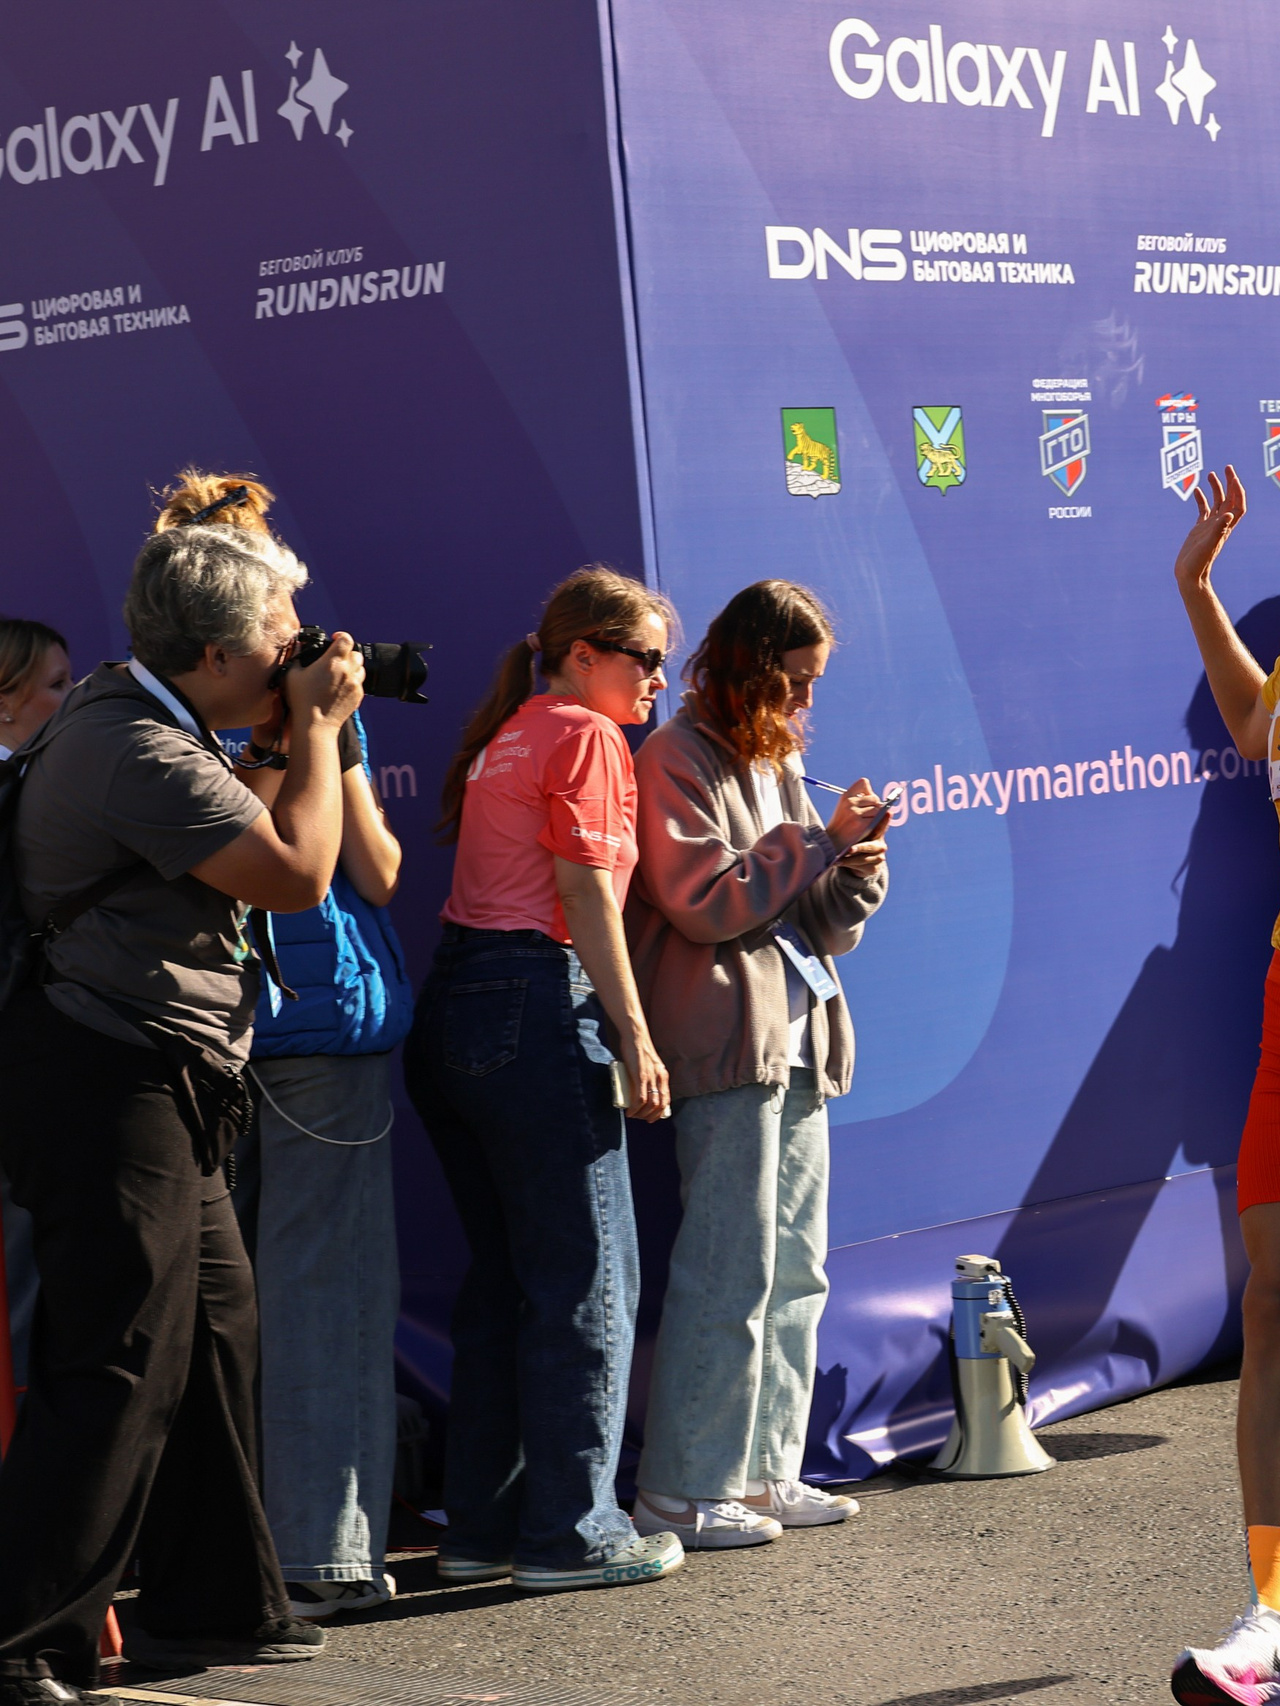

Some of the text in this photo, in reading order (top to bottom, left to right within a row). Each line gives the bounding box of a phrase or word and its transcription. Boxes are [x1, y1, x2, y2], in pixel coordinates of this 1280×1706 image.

[829, 17, 1141, 138] Galaxy AI
[0, 69, 260, 187] alaxy AI
[765, 226, 907, 282] DNS
[911, 229, 1028, 257] ЦИФРОВАЯ И
[1137, 233, 1227, 255] БЕГОВОЙ КЛУБ
[258, 246, 364, 277] БЕГОВОЙ КЛУБ
[912, 258, 1075, 286] БЫТОВАЯ ТЕХНИКА
[31, 283, 142, 321] ЦИФРОВАЯ И
[255, 261, 447, 320] RUNDNSRUN
[34, 313, 110, 346] БЫТОВАЯ
[113, 304, 191, 334] ТЕХНИКА
[1031, 391, 1092, 402] МНОГОБОРЬЯ
[1032, 378, 1088, 390] ФЕДЕРАЦИЯ
[1161, 412, 1196, 424] ИГРЫ
[1046, 427, 1084, 466] ГТО
[1166, 440, 1197, 474] ГТО
[1048, 507, 1092, 519] РОССИИ
[571, 826, 602, 842] DNS
[602, 1559, 663, 1582] crocs
